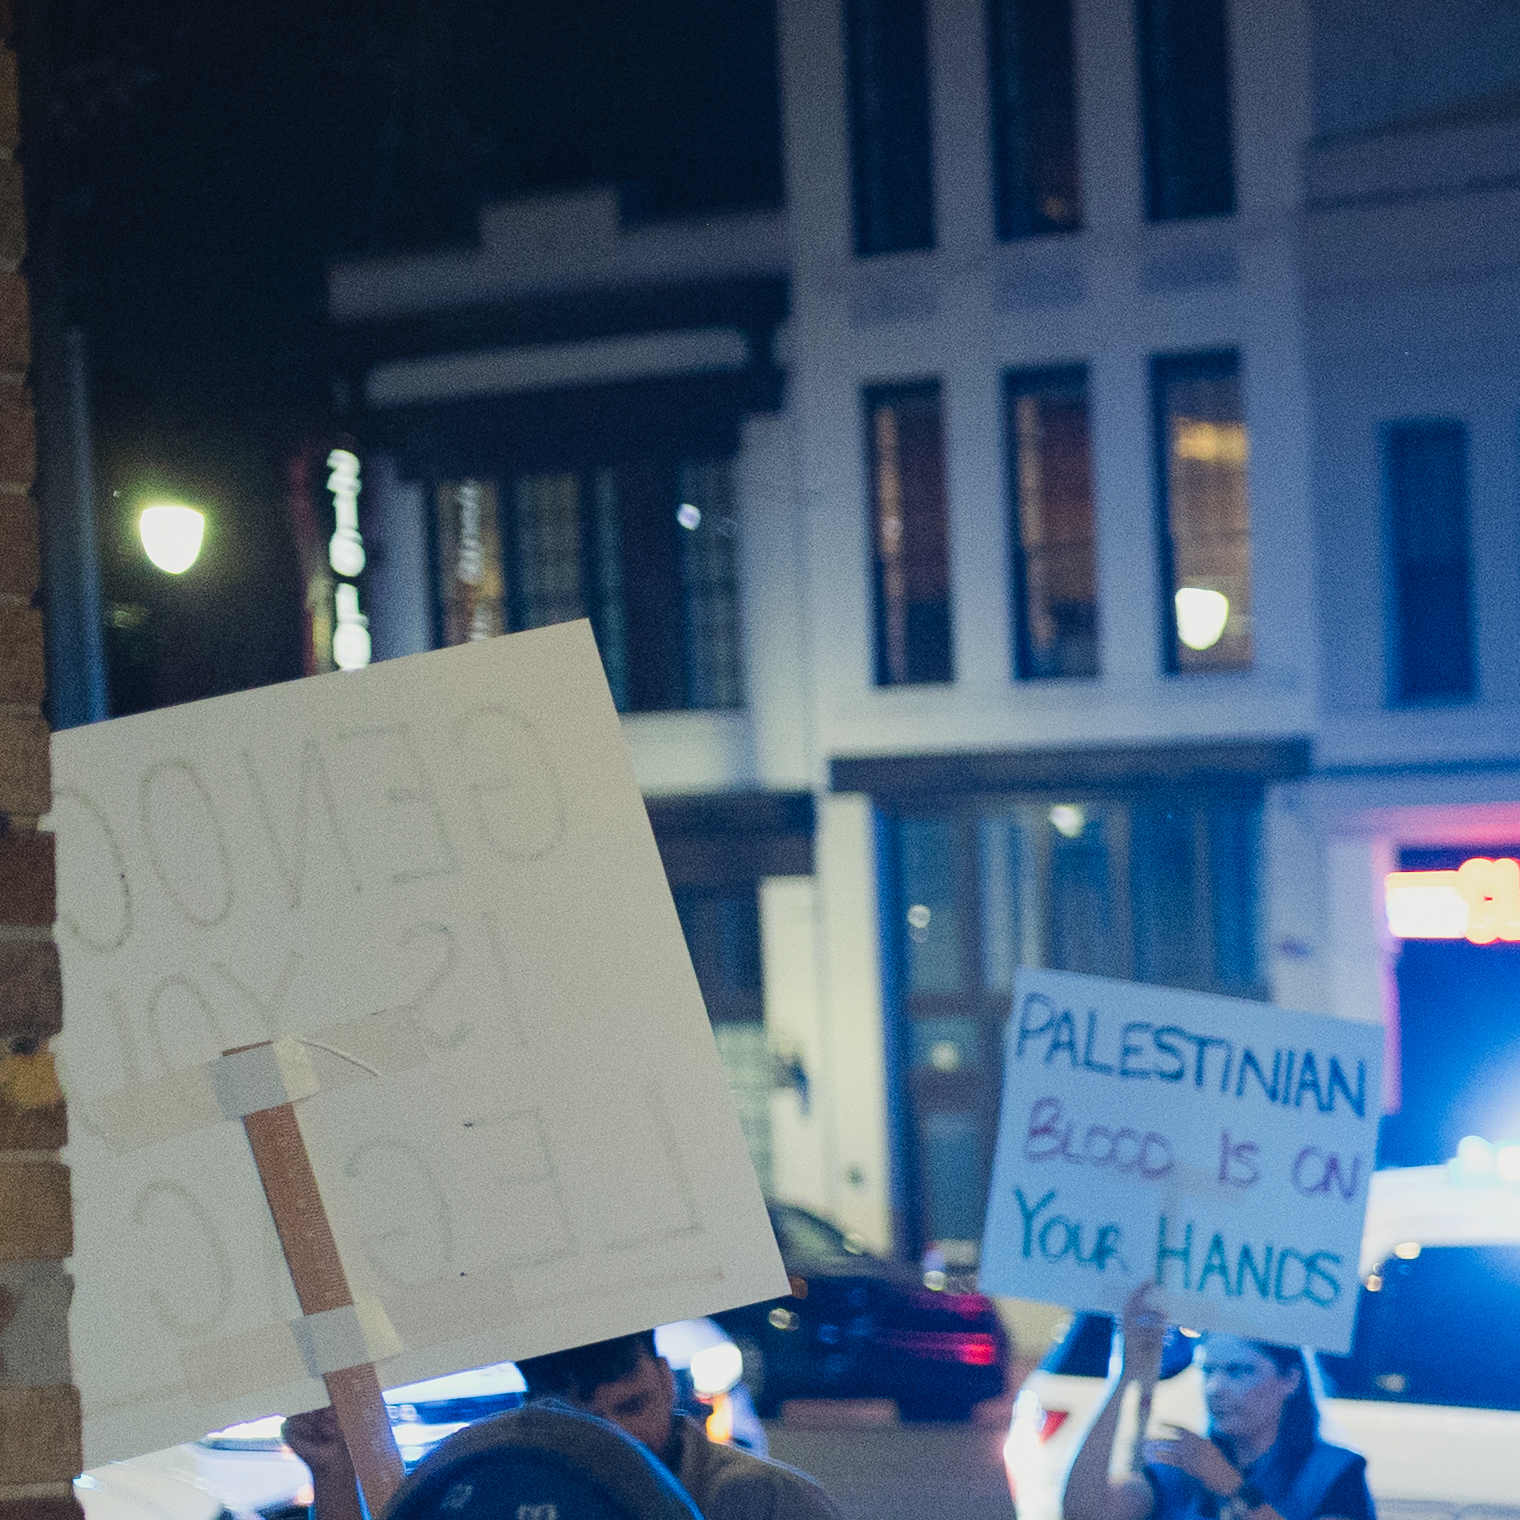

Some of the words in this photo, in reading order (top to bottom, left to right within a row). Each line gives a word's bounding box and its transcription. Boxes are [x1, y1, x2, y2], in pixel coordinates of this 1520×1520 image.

[1015, 992, 1367, 1119] PALESTINIAN
[1023, 1097, 1176, 1180] BLOOD
[1217, 1128, 1261, 1188] IS
[1291, 1146, 1362, 1203] ON
[1152, 1214, 1344, 1309] HANDS
